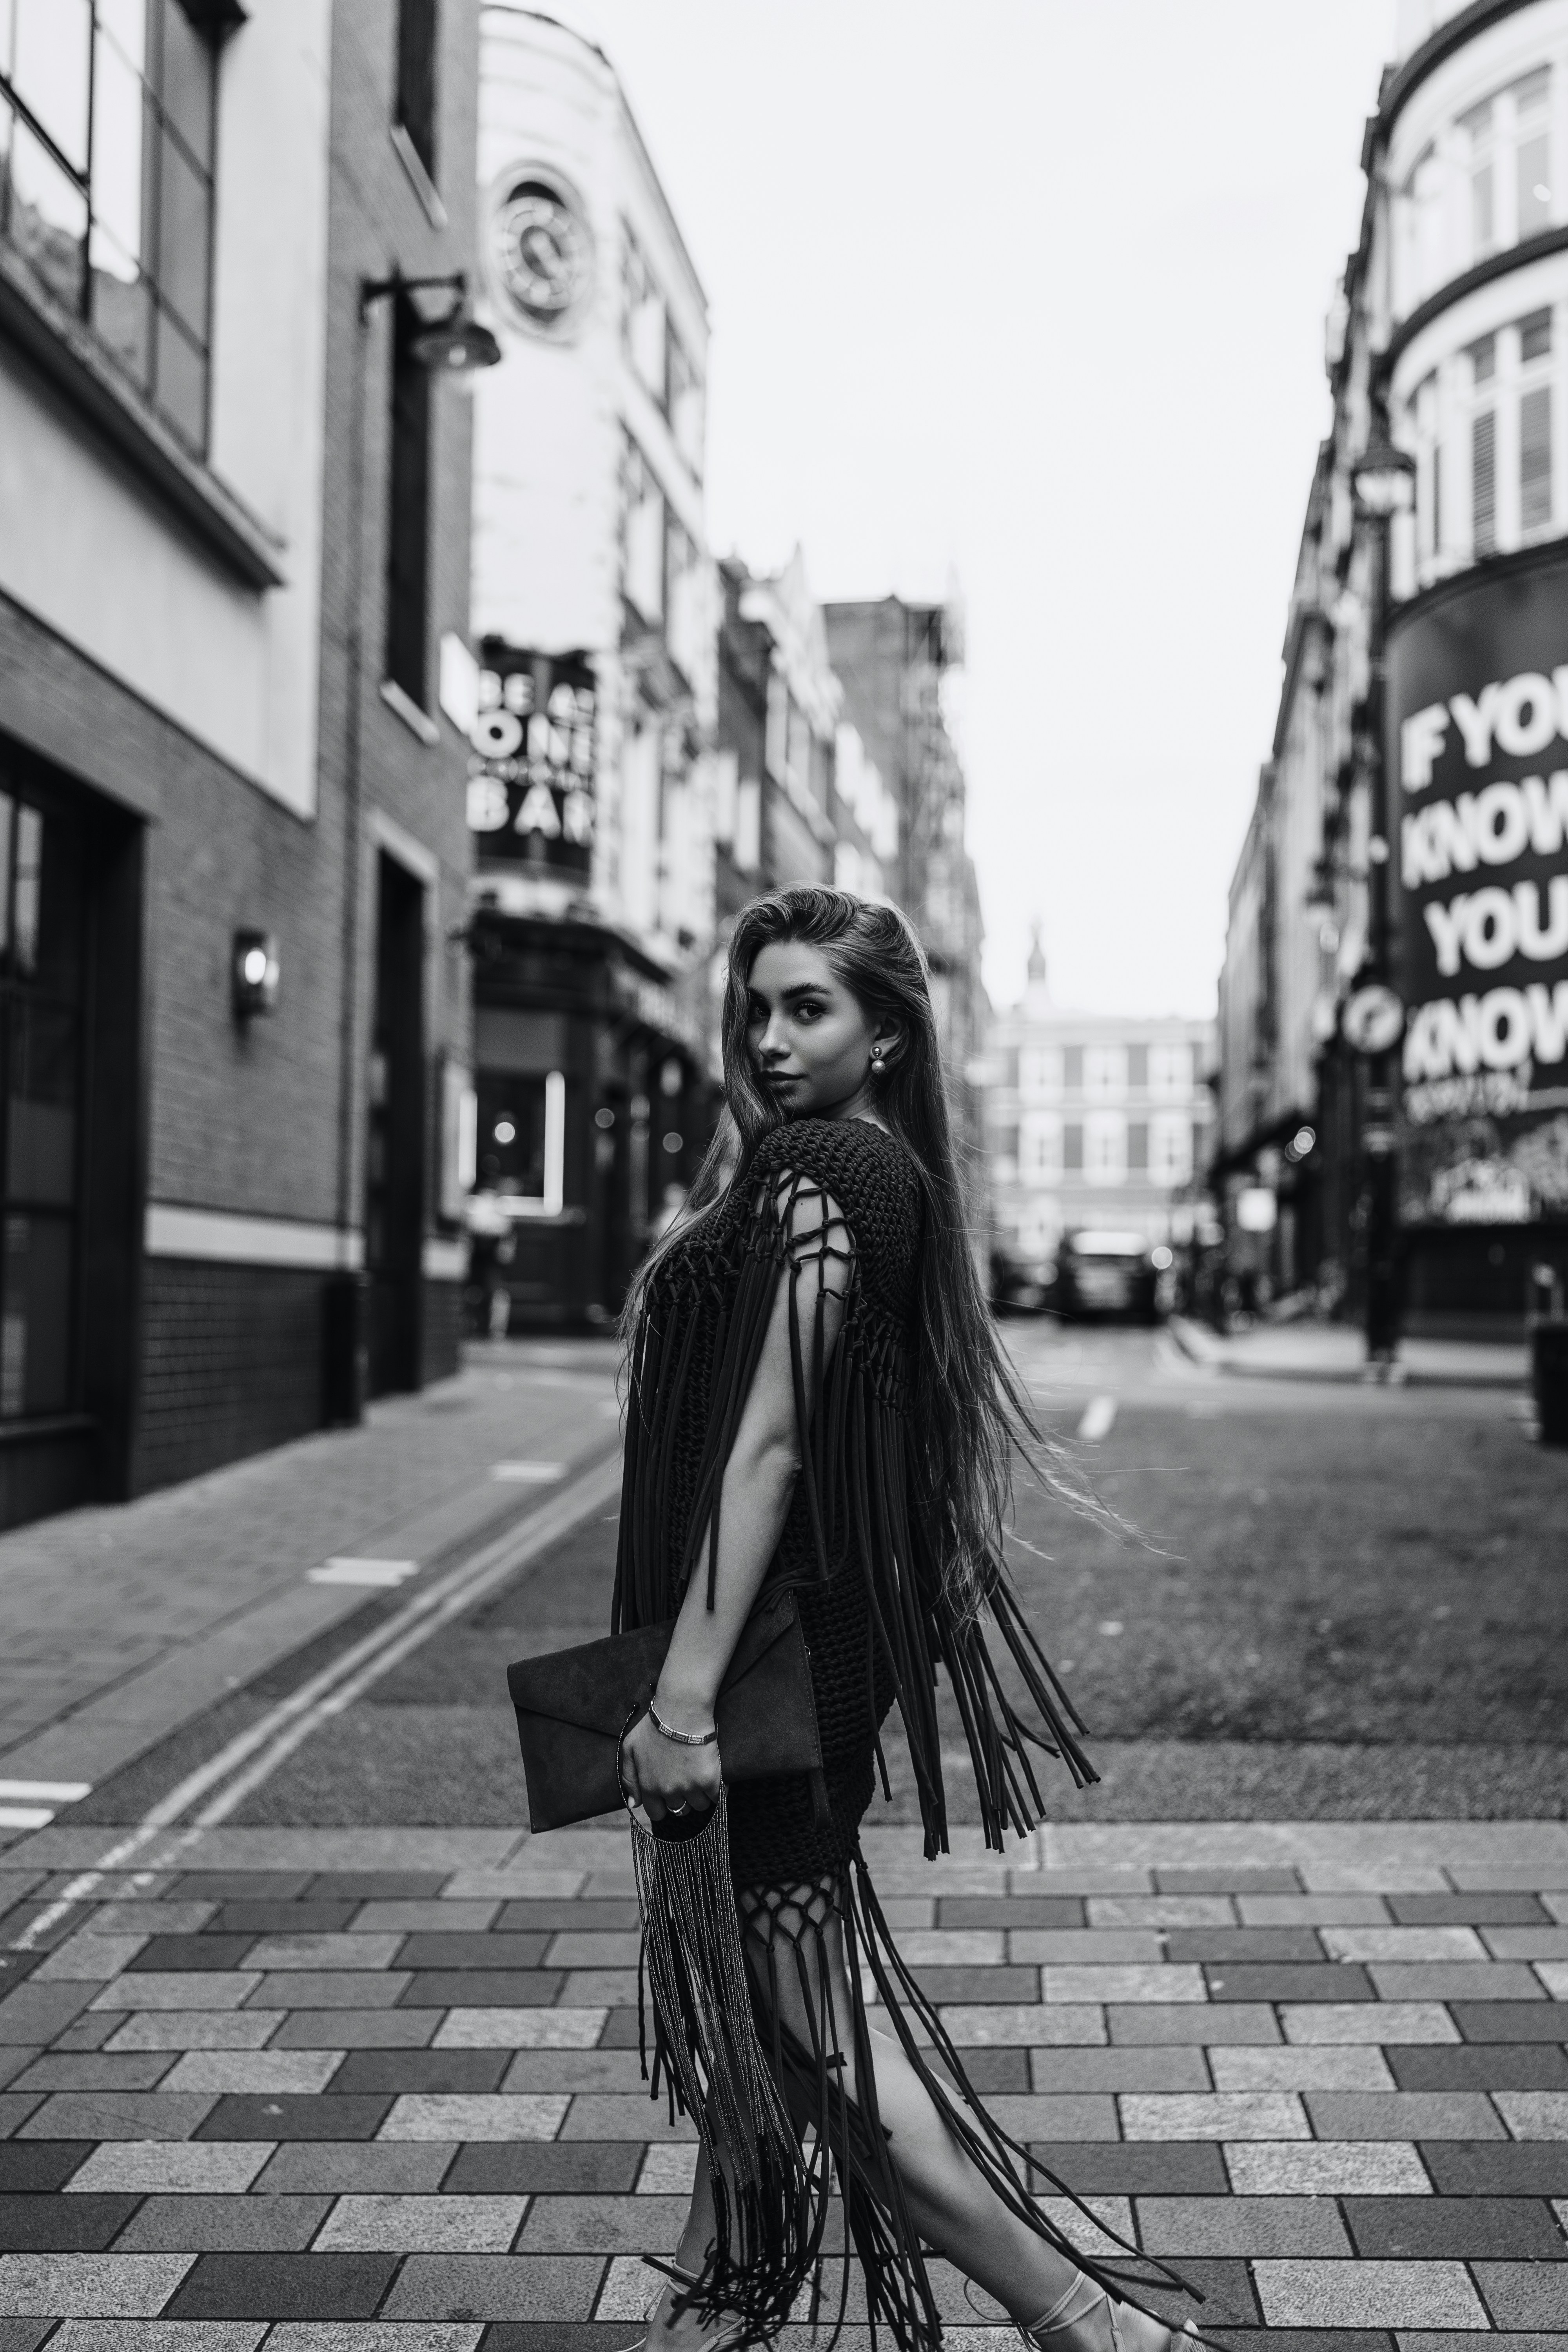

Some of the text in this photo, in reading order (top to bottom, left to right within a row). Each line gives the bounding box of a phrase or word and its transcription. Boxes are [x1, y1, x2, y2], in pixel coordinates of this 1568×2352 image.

[470, 709, 593, 775] ONE
[1450, 664, 1568, 768] YO
[466, 775, 595, 847] BAR
[1422, 873, 1568, 977] YOU
